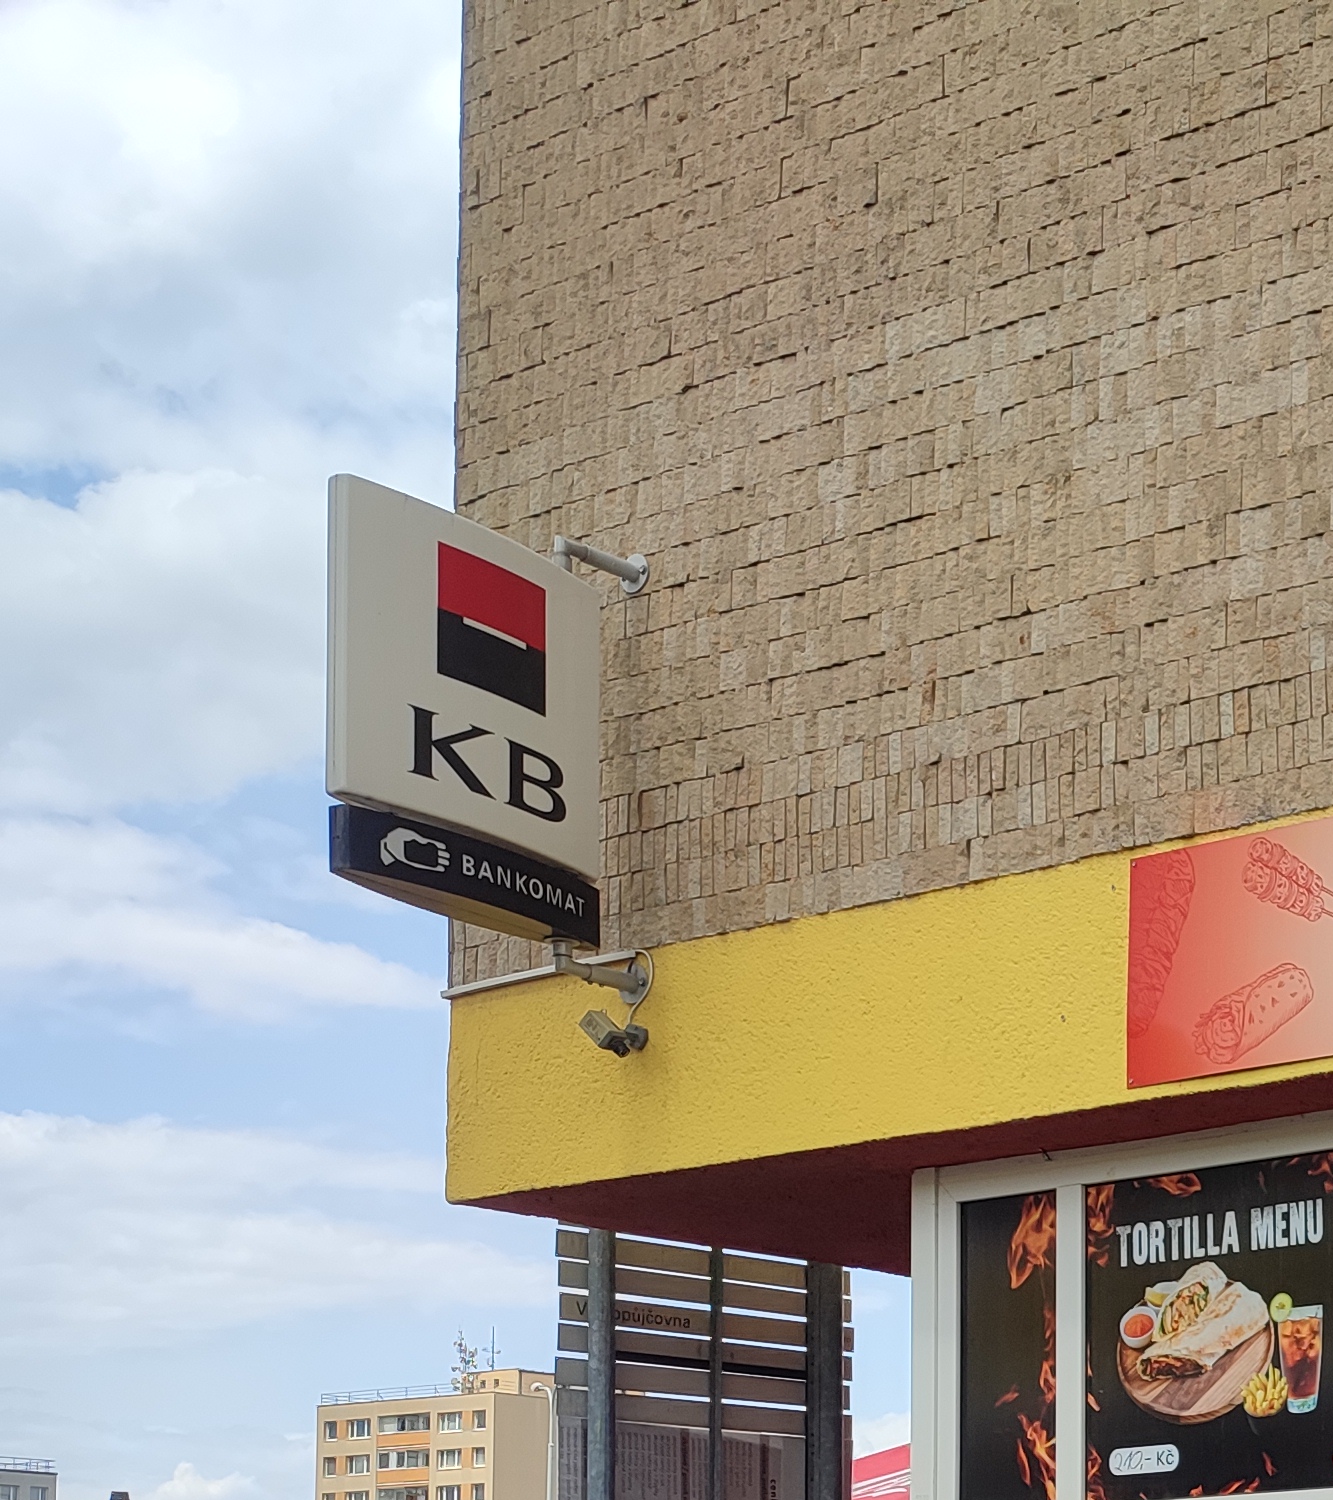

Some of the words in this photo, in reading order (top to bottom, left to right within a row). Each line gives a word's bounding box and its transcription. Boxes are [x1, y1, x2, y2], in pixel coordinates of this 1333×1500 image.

[406, 703, 567, 822] KB
[462, 854, 586, 918] BANKOMAT
[1115, 1210, 1240, 1268] TORTILLA
[1250, 1198, 1325, 1251] MENU
[1156, 1450, 1176, 1468] Kč
